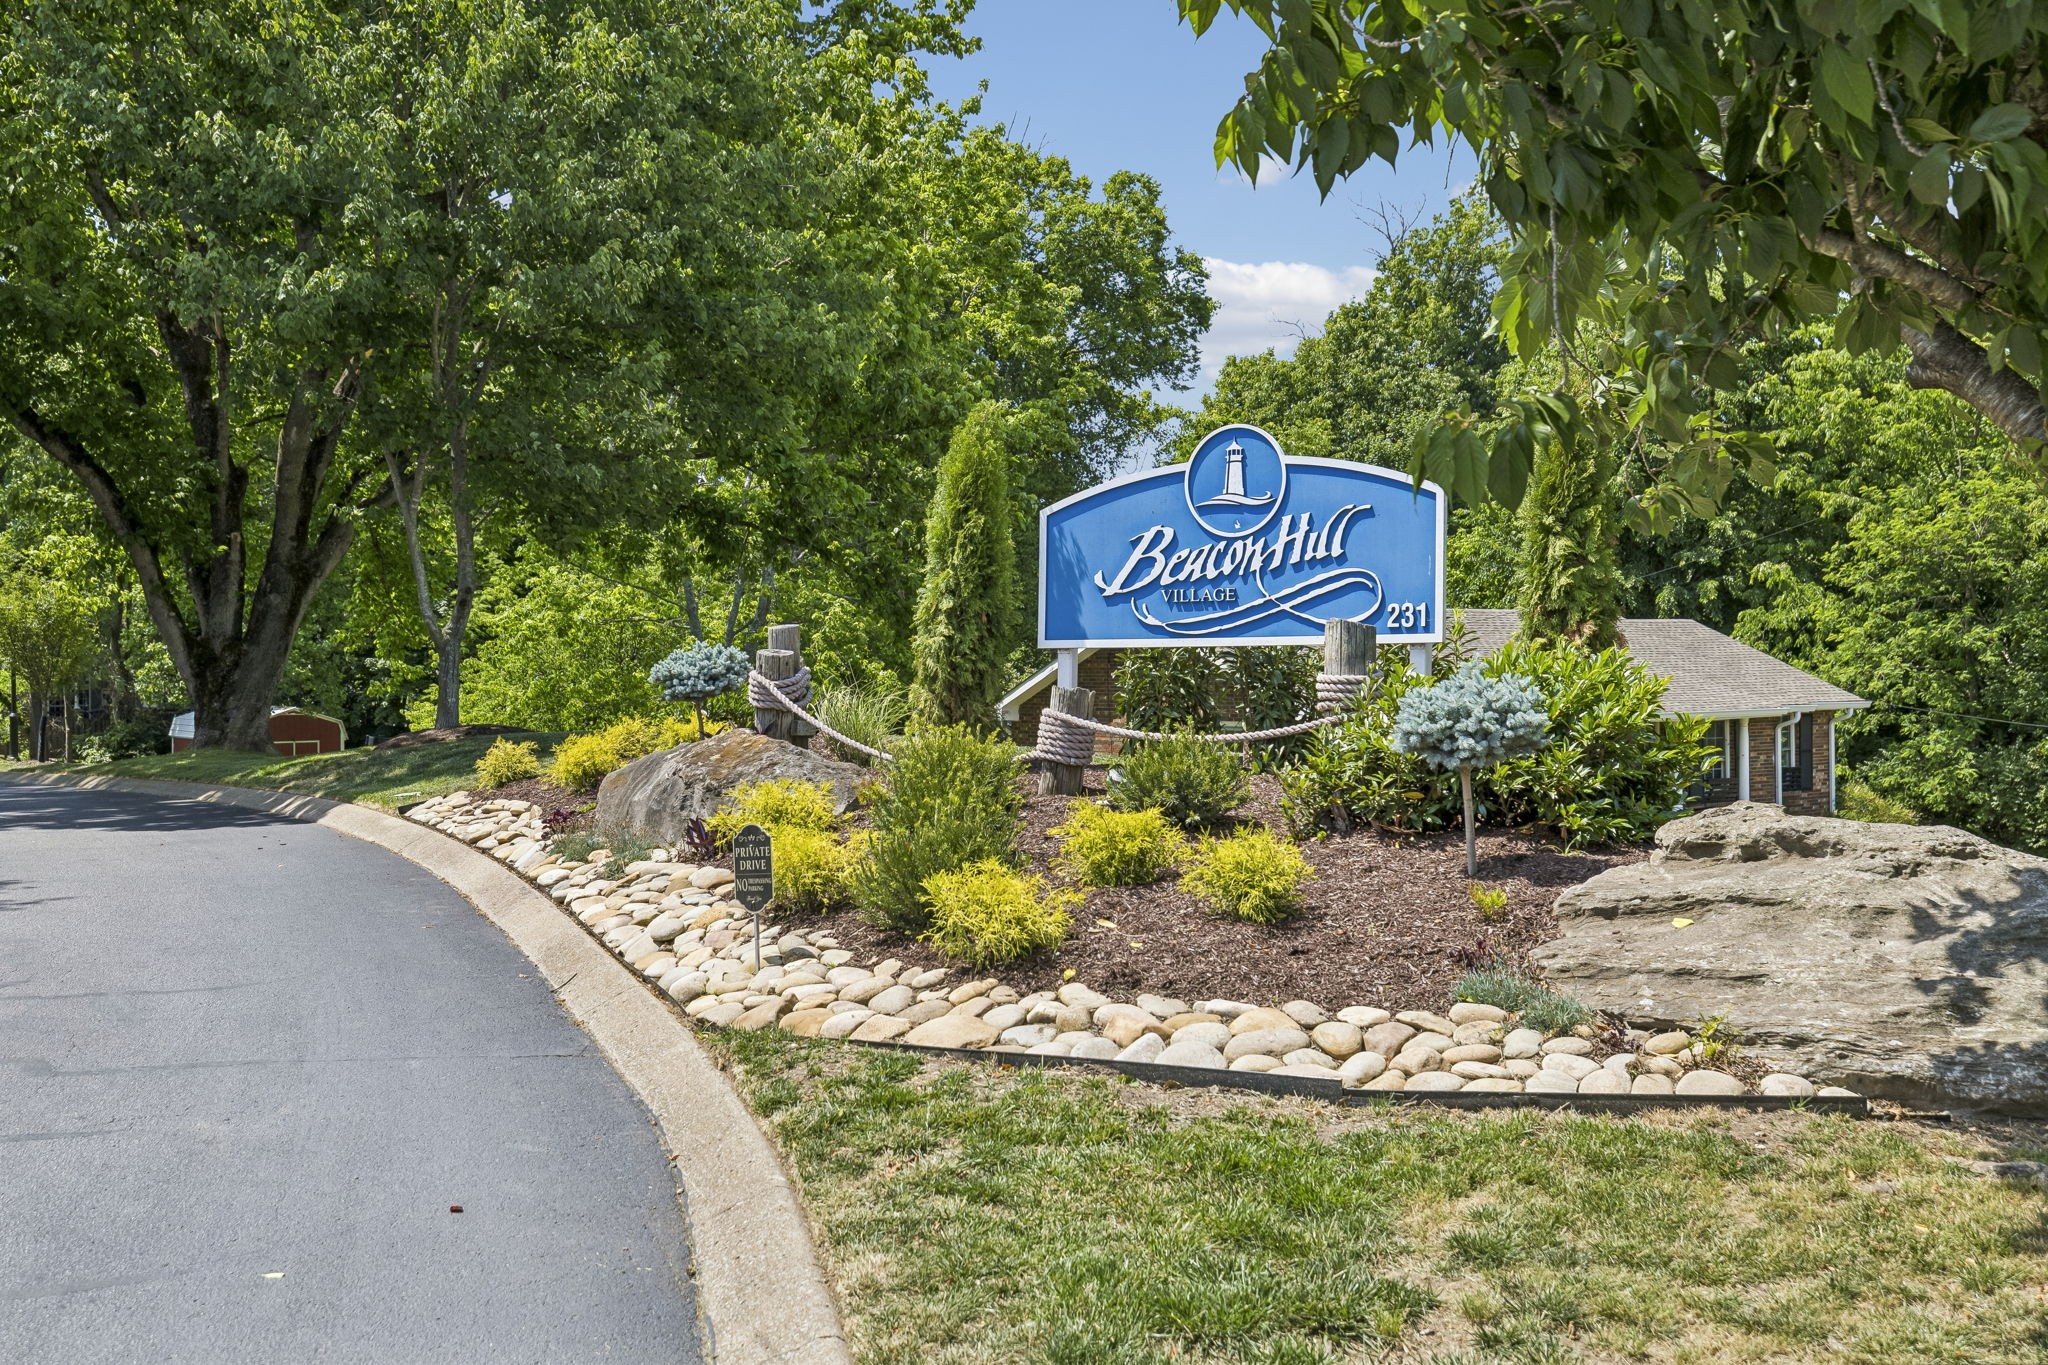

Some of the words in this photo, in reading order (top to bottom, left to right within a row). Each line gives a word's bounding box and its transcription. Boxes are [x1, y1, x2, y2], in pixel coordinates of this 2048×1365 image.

[1094, 525, 1266, 597] Beacon
[1262, 504, 1374, 570] Hill
[1161, 587, 1236, 602] VILLAGE
[1386, 602, 1427, 628] 231
[735, 846, 770, 858] PRIVATE
[739, 859, 767, 871] DRIVE
[736, 878, 748, 892] NO
